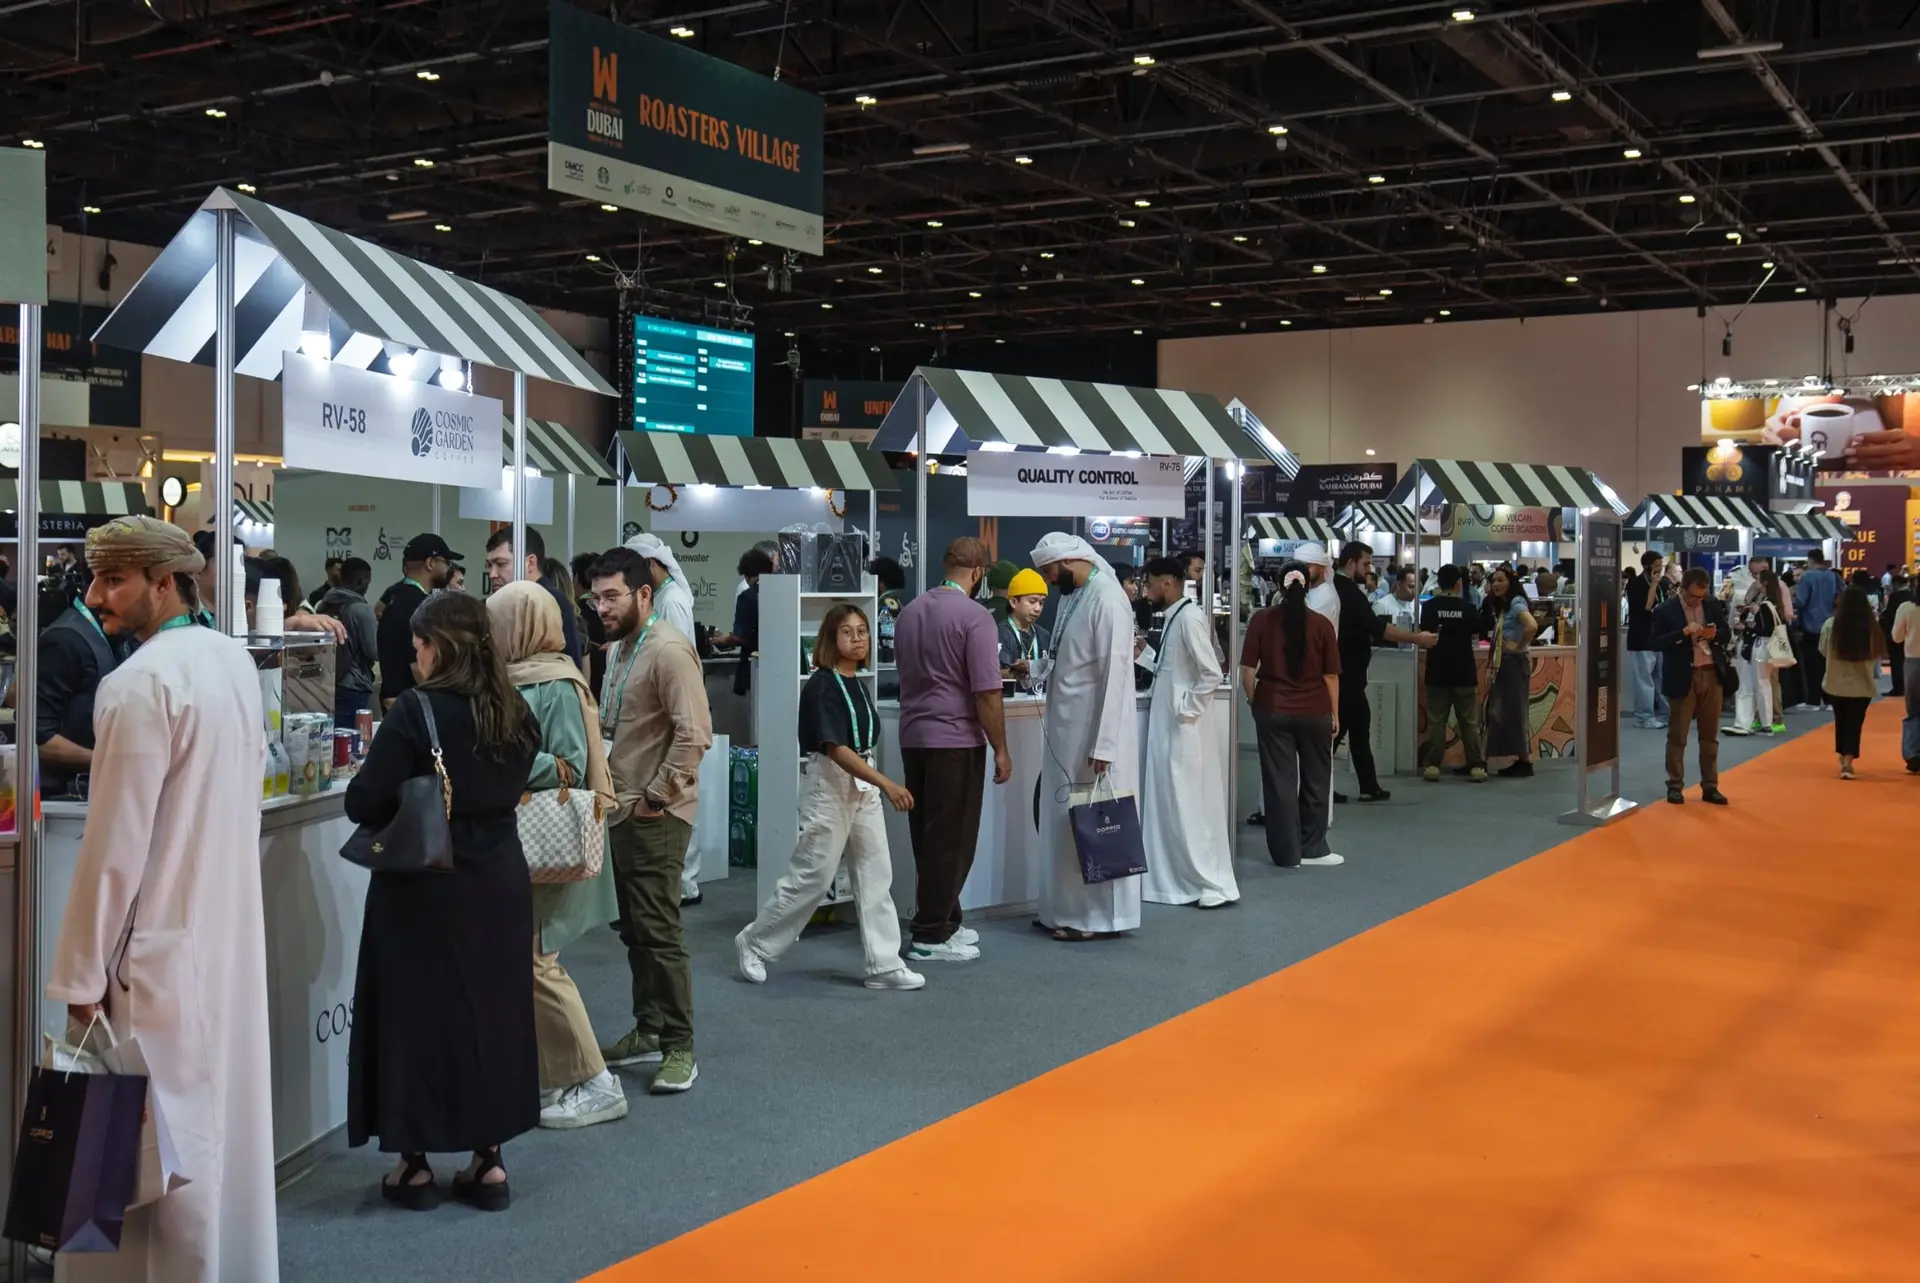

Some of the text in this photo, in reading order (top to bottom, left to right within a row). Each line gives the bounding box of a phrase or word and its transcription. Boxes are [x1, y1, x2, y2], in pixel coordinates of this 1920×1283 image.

[593, 46, 618, 103] W
[587, 108, 623, 140] DUBAI
[639, 94, 800, 173] ROASTERS VILLAGE
[823, 391, 837, 409] W
[322, 402, 366, 434] RV-58
[435, 410, 474, 433] COSMIC
[435, 431, 474, 451] GARDEN
[435, 451, 474, 465] COFFEE
[1159, 462, 1181, 472] RV-75
[1017, 468, 1139, 485] QUALITY CONTROL
[1360, 482, 1383, 490] DUBAI
[15, 520, 84, 530] RSTERIA
[1491, 524, 1516, 533] COFFEE
[1697, 529, 1720, 547] berry
[1282, 543, 1301, 554] SUCA
[1848, 548, 1866, 561] OF
